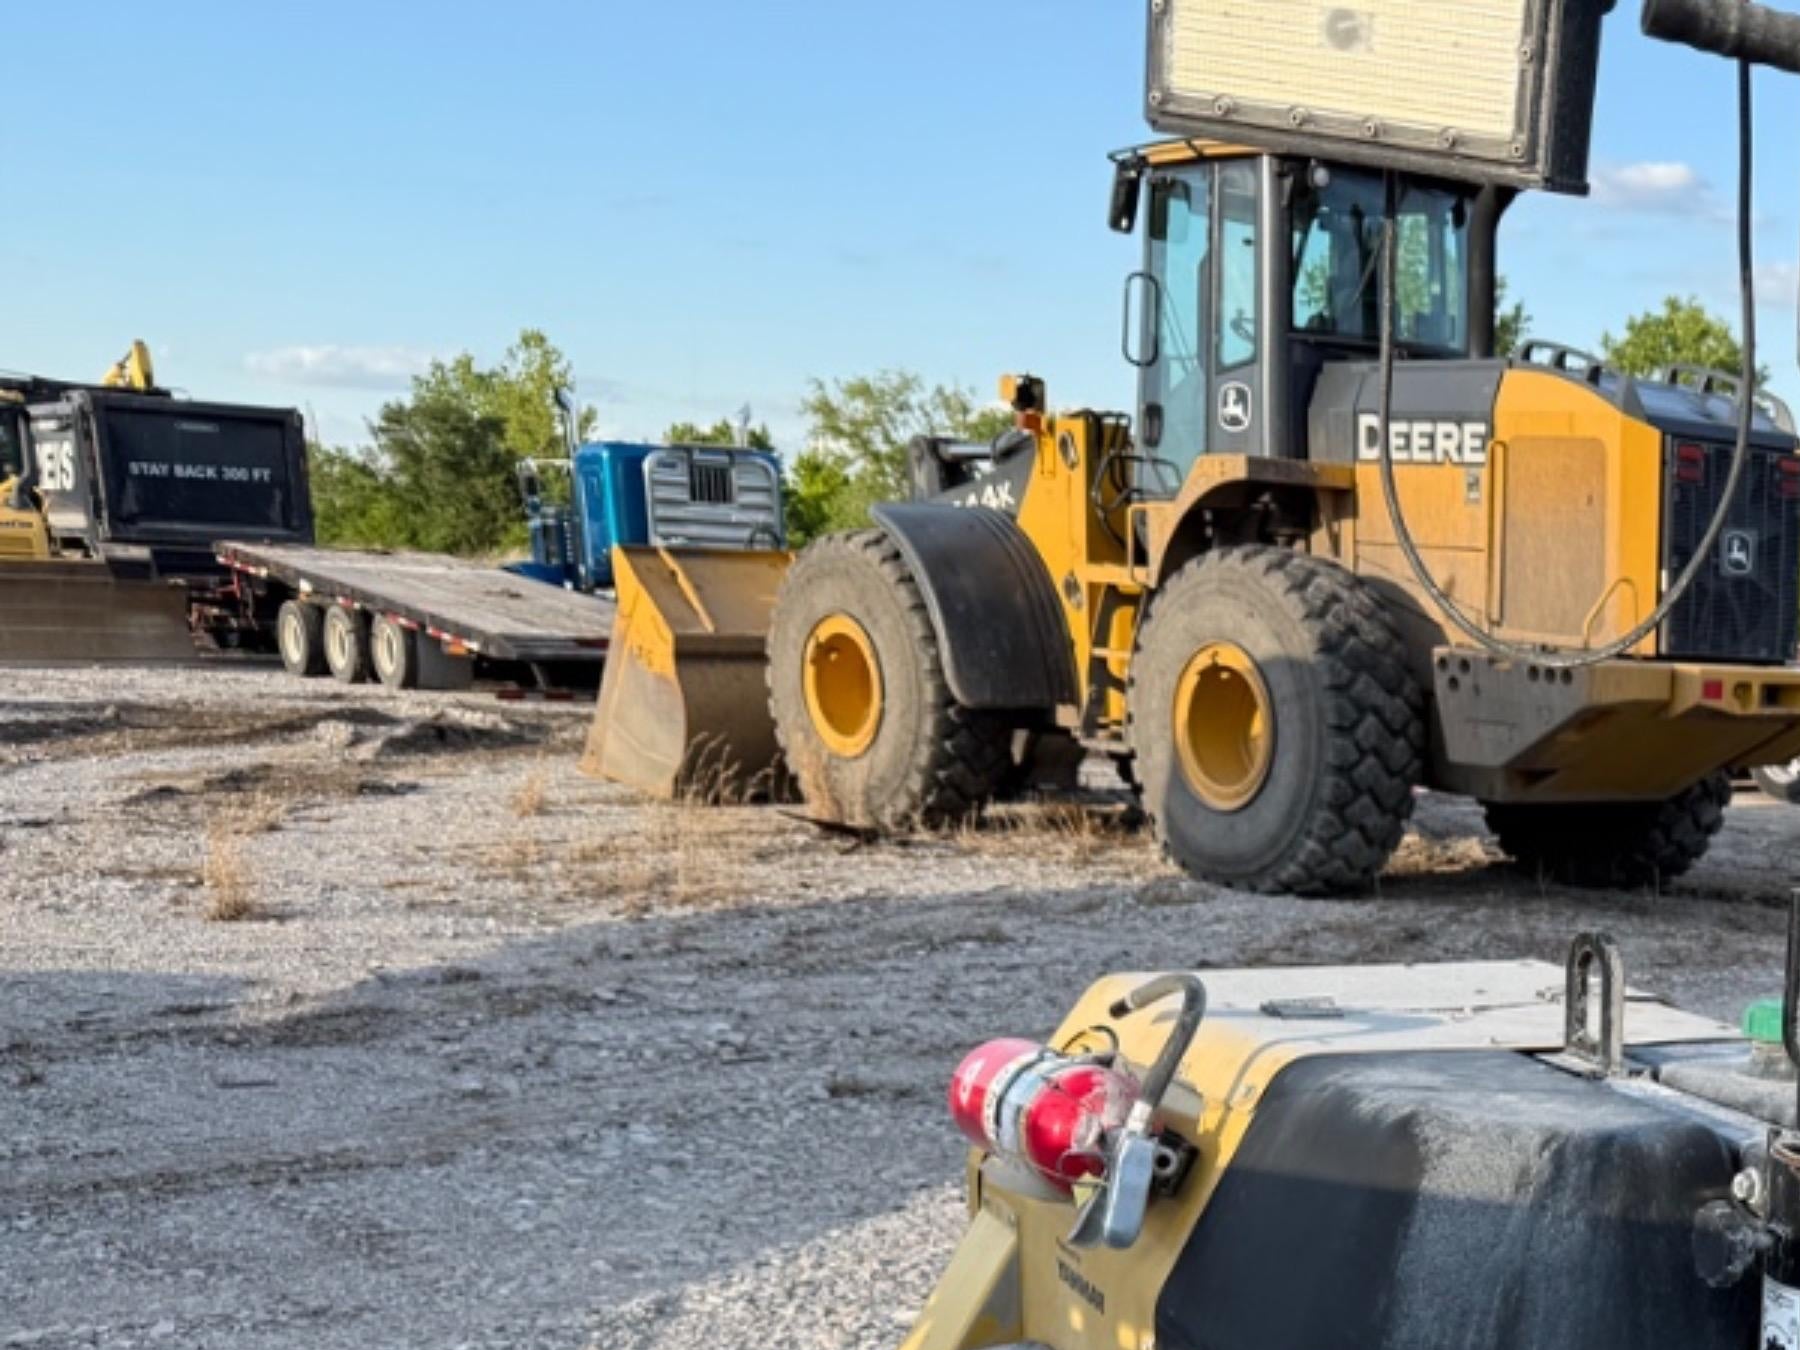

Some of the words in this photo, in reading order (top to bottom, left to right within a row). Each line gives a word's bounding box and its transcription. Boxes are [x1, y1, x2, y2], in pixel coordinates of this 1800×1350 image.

[1357, 412, 1487, 464] DEERE
[128, 461, 169, 477] STAY
[173, 463, 218, 479] BACK
[252, 467, 271, 482] FT
